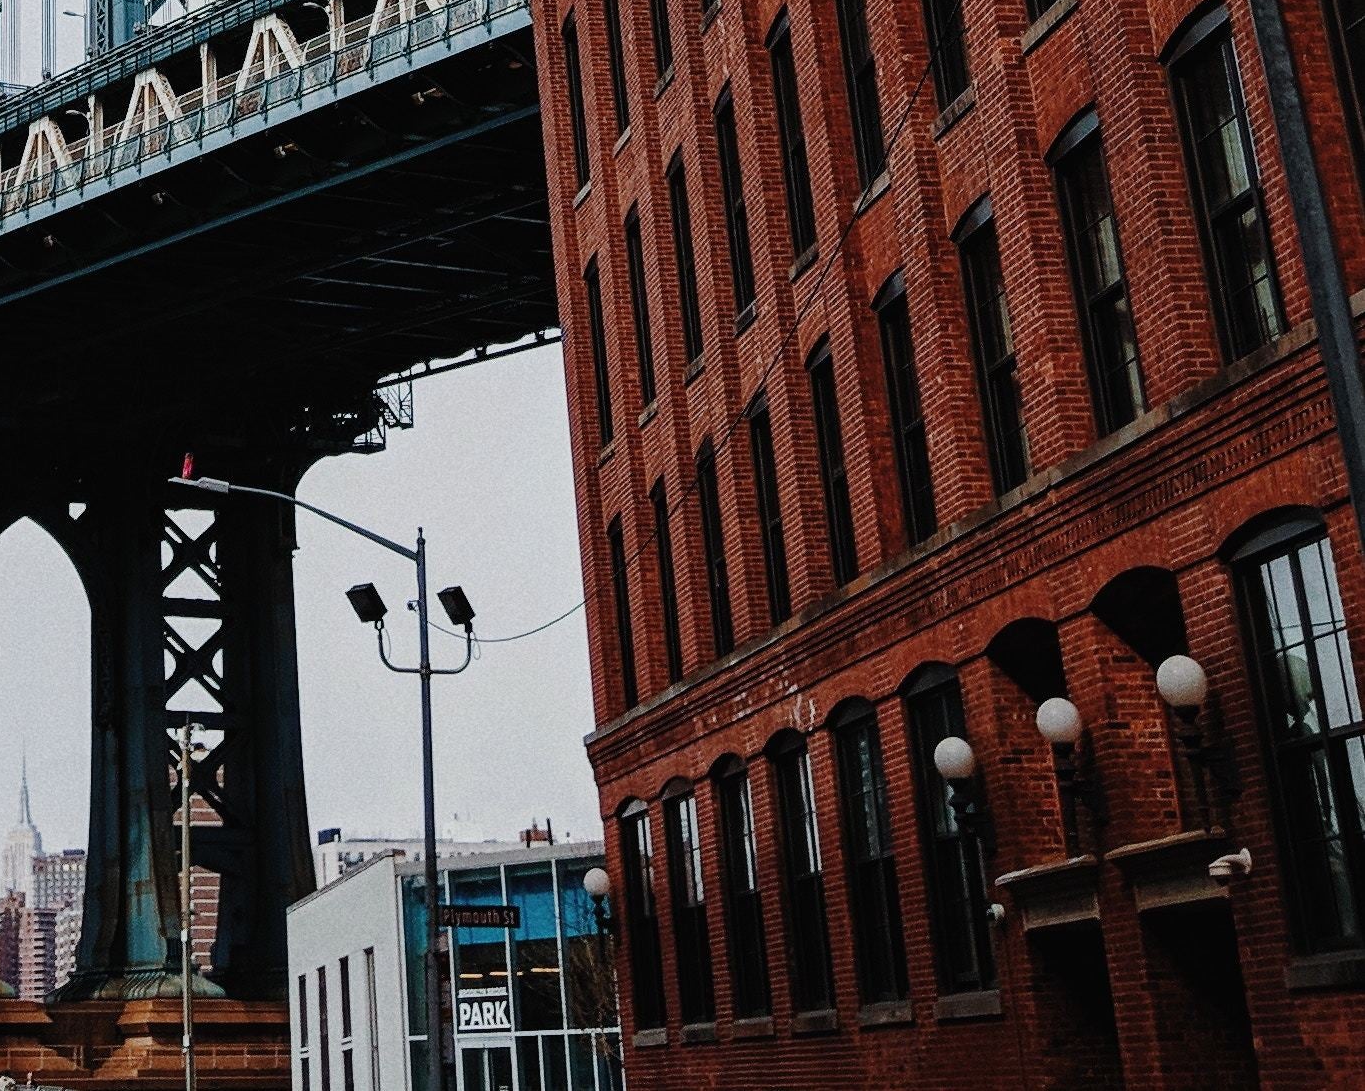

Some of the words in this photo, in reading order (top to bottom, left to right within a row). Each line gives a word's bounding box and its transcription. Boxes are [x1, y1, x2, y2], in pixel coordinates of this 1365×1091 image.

[443, 908, 499, 926] Plymouth
[503, 909, 515, 925] St
[458, 1000, 510, 1027] PARK
